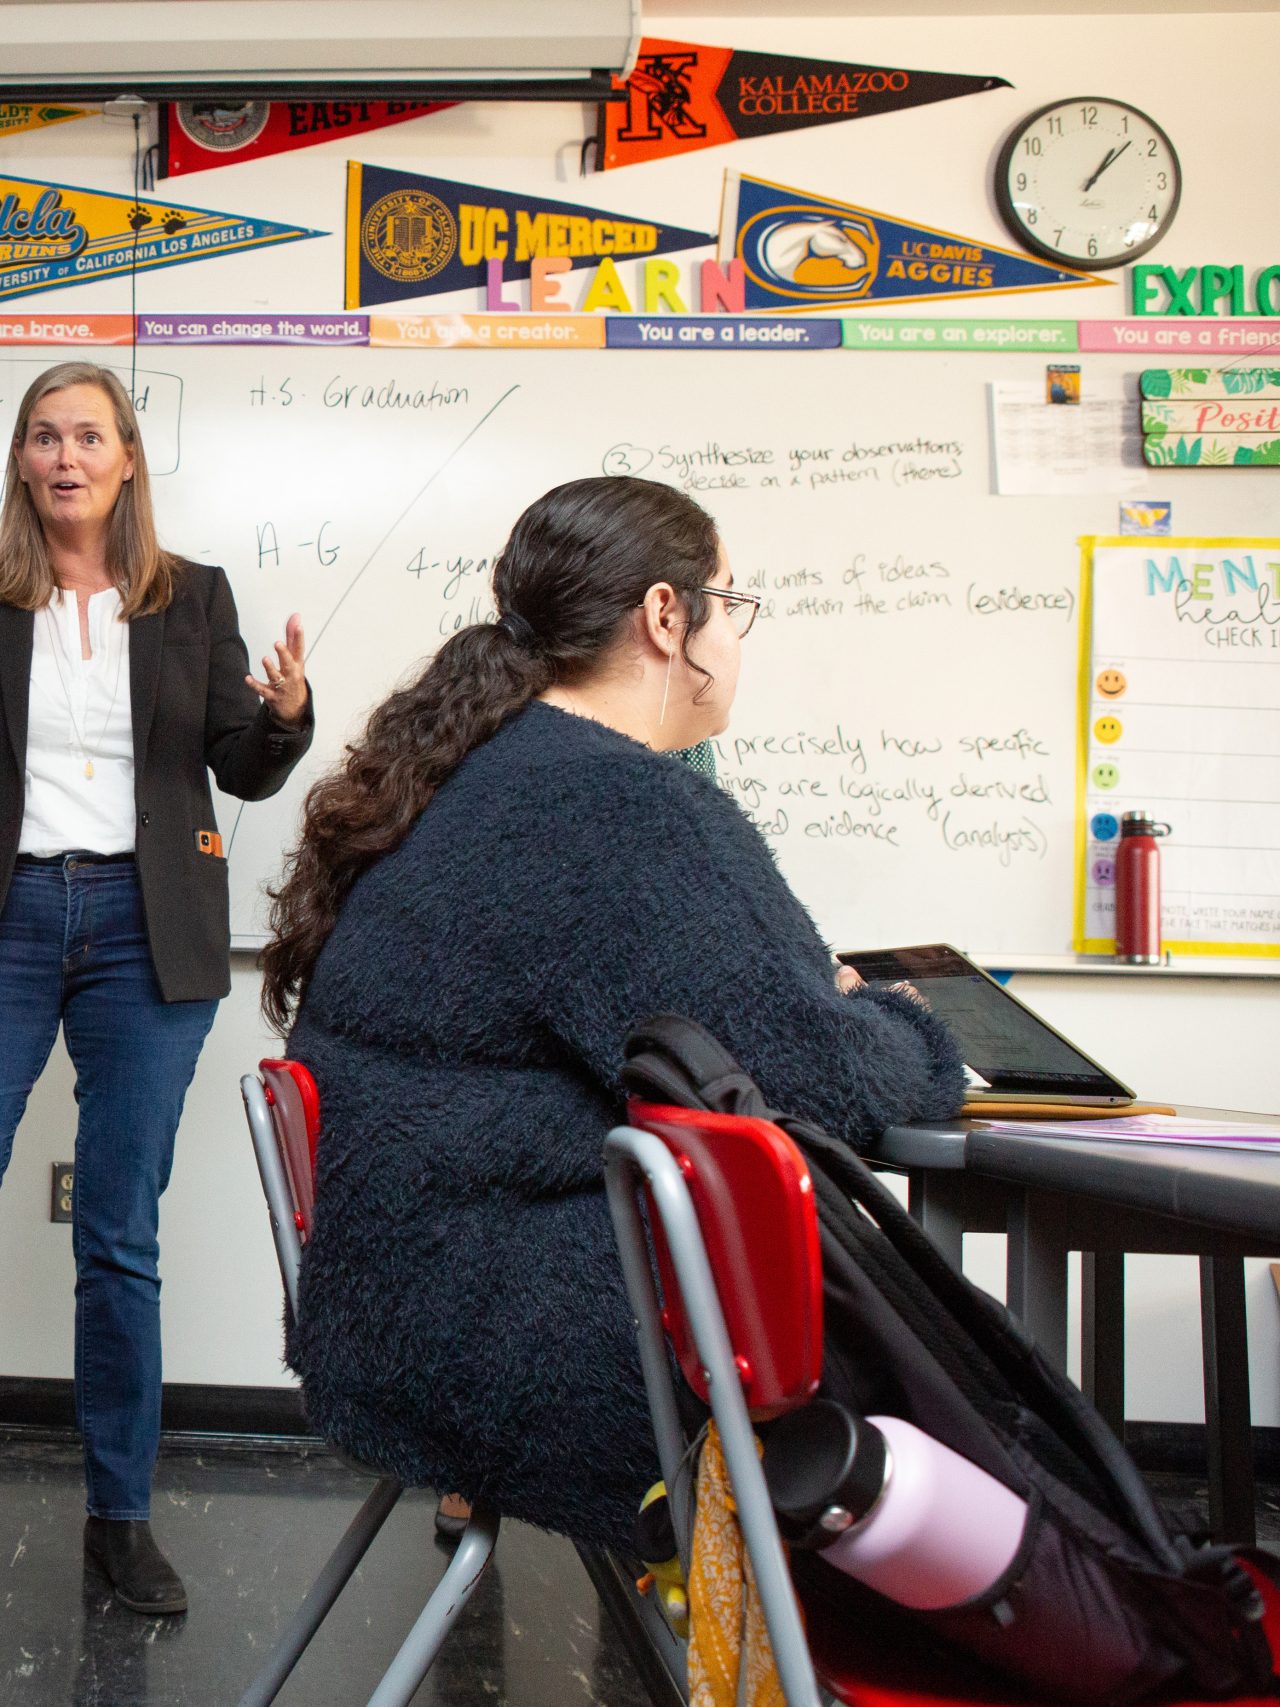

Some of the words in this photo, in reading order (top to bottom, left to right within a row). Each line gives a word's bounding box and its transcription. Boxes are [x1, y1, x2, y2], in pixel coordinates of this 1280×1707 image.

[738, 71, 910, 97] KALAMAZOO
[738, 93, 859, 116] COLLEGE
[1081, 106, 1099, 125] 12
[287, 102, 373, 136] EAST
[1047, 117, 1062, 135] 11
[1121, 115, 1129, 134] 1
[1024, 137, 1042, 156] 10
[1147, 138, 1158, 157] 2
[1016, 172, 1027, 191] 9
[1156, 172, 1167, 191] 3
[1027, 208, 1038, 225] 8
[1147, 205, 1158, 222] 4
[458, 203, 509, 266] UC
[515, 210, 658, 262] MERCED
[1053, 229, 1063, 247] 7
[58, 266, 70, 277] OF
[75, 247, 158, 272] CALIFORNIA
[161, 237, 188, 255] LOS
[192, 224, 255, 249] ANGELES
[1087, 238, 1098, 257] 6
[486, 256, 746, 313] LEARN
[885, 260, 994, 287] AGGIES
[1132, 264, 1280, 317] EXPLO
[30, 320, 95, 338] brave.
[144, 321, 174, 336] You
[178, 323, 208, 336] can
[212, 320, 272, 339] change
[277, 320, 306, 336] the
[310, 320, 363, 337] world.
[397, 323, 430, 340] You
[437, 324, 472, 339] are
[479, 325, 490, 340] a
[497, 323, 579, 340] creator.
[638, 323, 673, 341] You
[678, 327, 715, 341] are
[720, 327, 735, 341] a
[739, 323, 810, 342] leader.
[858, 324, 894, 342] You
[899, 327, 935, 342] are
[942, 328, 968, 342] an
[973, 325, 1066, 348] explorer.
[1113, 327, 1150, 344] You
[1155, 330, 1192, 345] are
[1198, 331, 1212, 345] a
[322, 375, 469, 411] Graduation
[1193, 400, 1280, 434] Posit
[658, 440, 776, 479] Synthesize
[789, 449, 835, 472] your
[683, 472, 751, 491] decide
[761, 475, 782, 488] on
[809, 466, 880, 490] pattern
[747, 568, 767, 590] all
[773, 568, 823, 591] units
[842, 554, 867, 593] of
[878, 557, 951, 584] ideas
[1145, 555, 1280, 600] MENT
[786, 599, 845, 619] within
[854, 595, 890, 619] the
[896, 588, 952, 612] claim
[1175, 579, 1280, 624] heal
[1204, 627, 1263, 648] CHECK
[734, 724, 867, 775] precisely
[881, 729, 943, 758] how
[959, 728, 1051, 761] specific
[778, 779, 829, 798] are
[840, 775, 943, 821] logically
[950, 773, 1053, 806] derived
[804, 810, 900, 848] evidence
